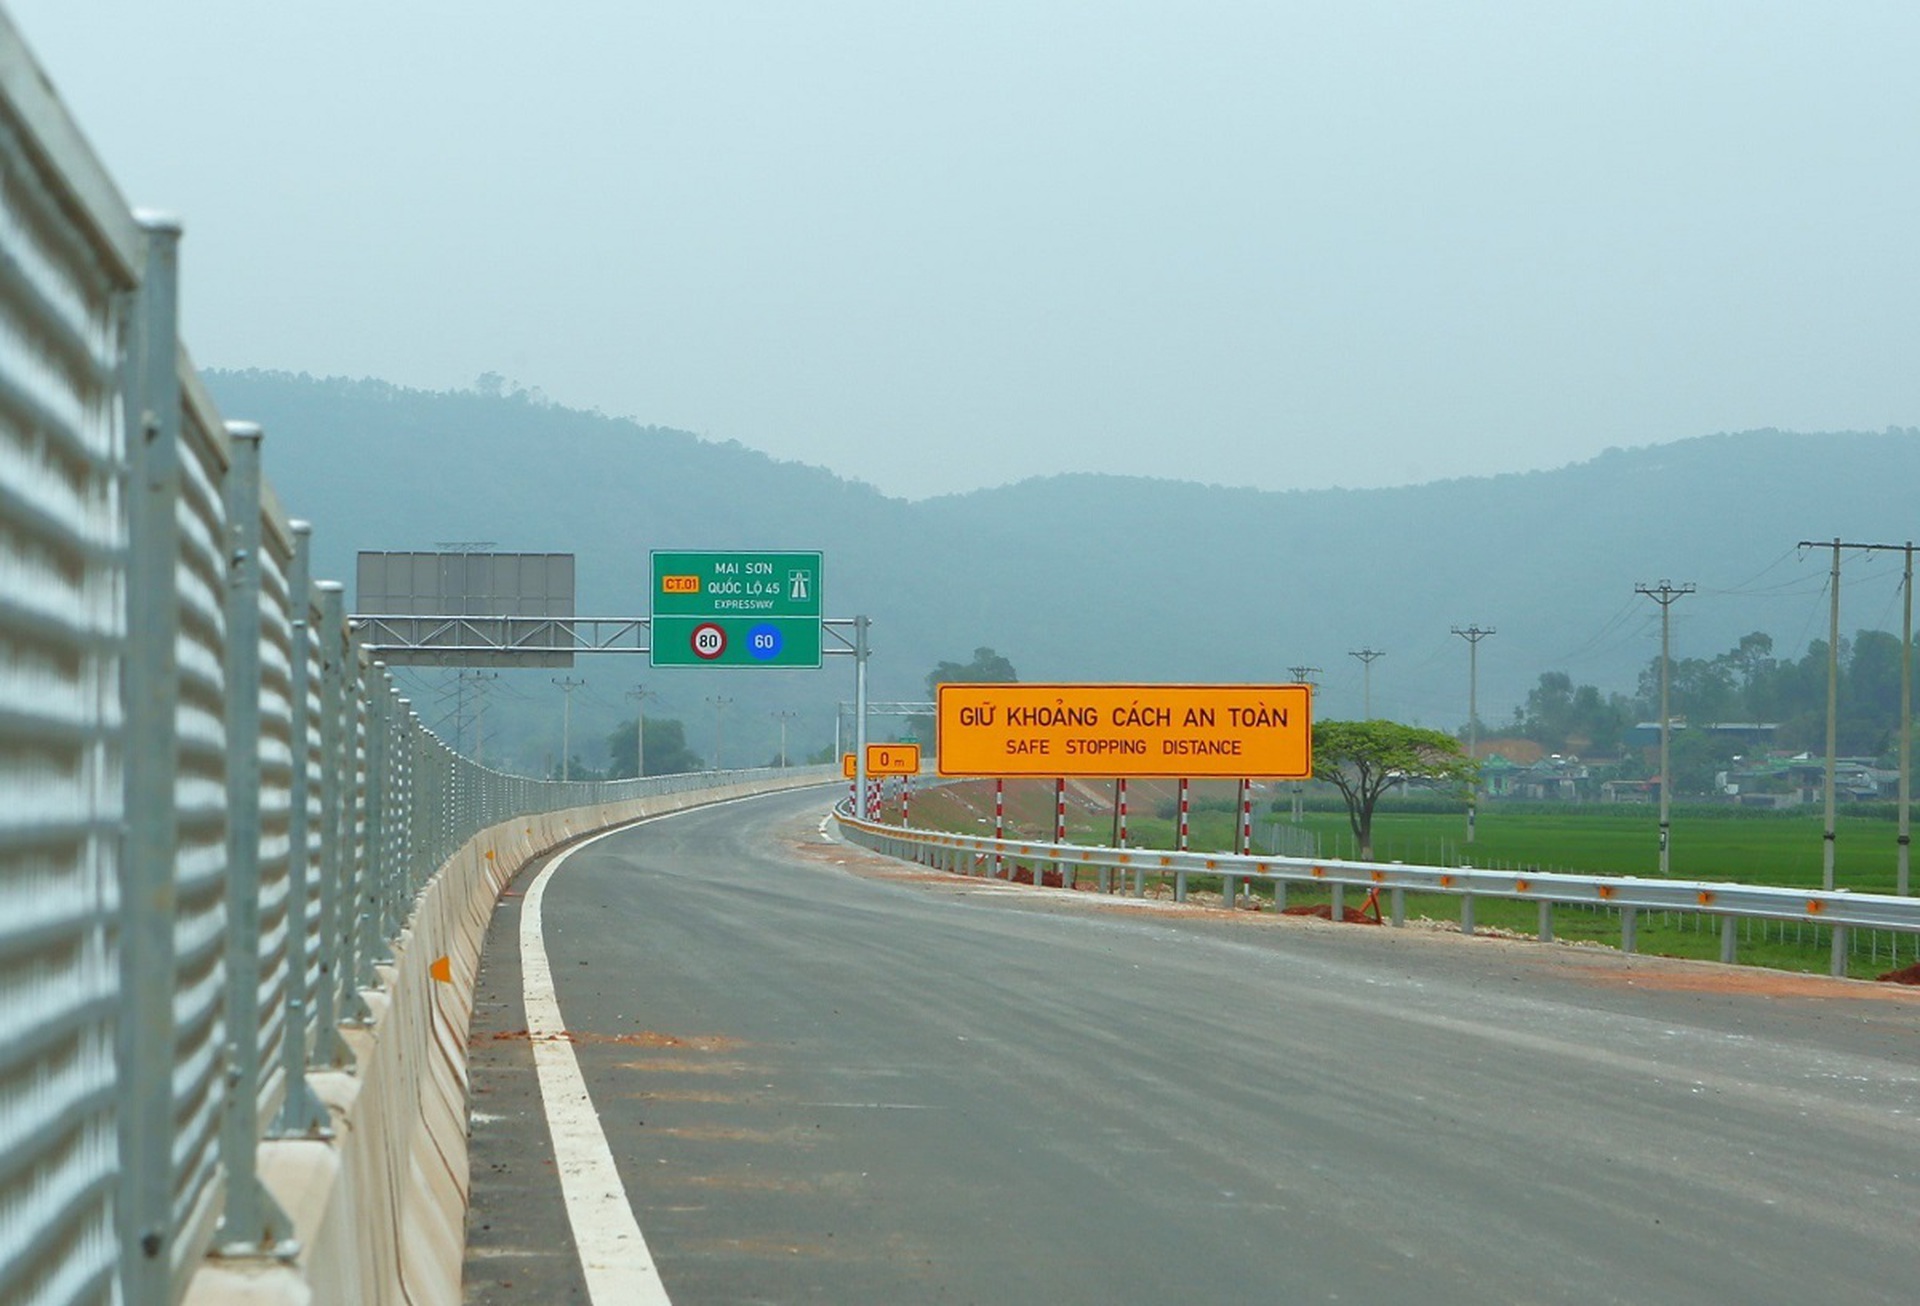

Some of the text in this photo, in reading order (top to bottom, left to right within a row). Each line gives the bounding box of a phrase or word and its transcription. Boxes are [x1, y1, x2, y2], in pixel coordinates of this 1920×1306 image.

[715, 562, 773, 574] MAI SƠN
[666, 578, 697, 590] CT.01
[708, 577, 780, 597] QUỐC LỘ 45
[714, 599, 774, 609] EXPRESSWAY
[699, 634, 718, 648] 80
[754, 634, 774, 648] 60
[960, 698, 1288, 727] GIỮ KHOẢNG CÁCH AN TOÀN
[1006, 739, 1242, 755] SAFE STOPPING DISTANCE
[881, 751, 904, 767] 0 m
